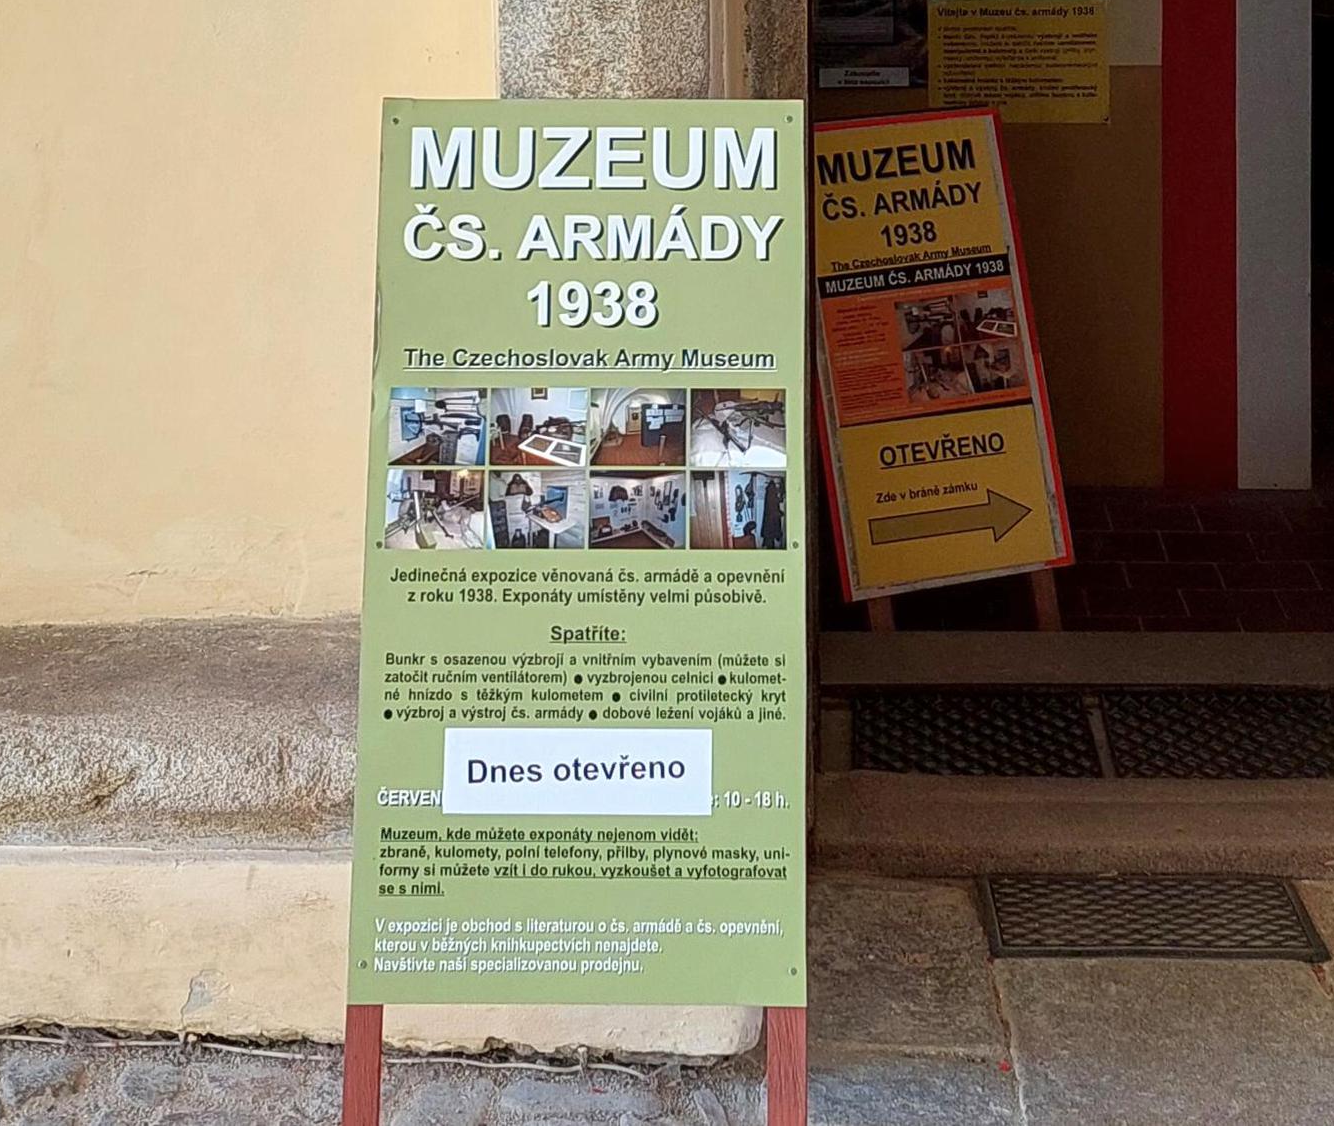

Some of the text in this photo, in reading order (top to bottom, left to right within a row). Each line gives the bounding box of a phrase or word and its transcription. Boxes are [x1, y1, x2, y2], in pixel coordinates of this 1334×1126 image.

[980, 8, 1012, 16] Muzeu
[1032, 7, 1068, 18] armády
[409, 126, 777, 190] MUZEUM
[817, 138, 976, 186] MUZEUM
[822, 179, 982, 222] ČS. ARMÁDY
[403, 204, 784, 262] ČS. ARMÁDY
[880, 220, 938, 248] 1938
[831, 244, 992, 272] The Czechoslovak Army Museum
[825, 276, 885, 294] MUZEUM
[888, 273, 912, 285] ČS.
[914, 263, 972, 283] ARMÁDY
[976, 259, 1004, 274] 1938
[526, 281, 659, 327] 1938
[404, 347, 775, 371] The Czechoslovak Army Museum
[880, 432, 1006, 467] OTEVŘENO
[876, 480, 978, 503] Zde v bráně zámku
[390, 568, 785, 586] Jedinečná expozice věnovaná čs. armádě a opevnění
[407, 589, 766, 606] z roku 1938. Exponáty umístěny velmi působivě.
[550, 626, 626, 643] Spatříte:
[386, 653, 785, 669] Bunkr s osazenou výzbrojí a vnitřním vybavením (můžete si
[385, 671, 786, 687] zatočit ručním ventilátorem) vyzbrojenou celnici kulomet-
[385, 689, 400, 701] né
[409, 689, 452, 701] hnízdo
[461, 693, 468, 701] s
[477, 689, 522, 704] těžkým
[531, 689, 603, 701] kulometem
[630, 689, 667, 701] civilní
[762, 690, 786, 705] kryt
[396, 707, 785, 723] výzbroj a výstroj čs. armády dobové ležení vojáků a jiné.
[467, 755, 686, 783] Dnes otevřeno
[724, 791, 741, 807] 10
[755, 792, 772, 808] 18
[776, 791, 790, 808] h.
[380, 828, 442, 841] Muzeum,
[446, 828, 471, 839] kde
[476, 828, 524, 839] můžete
[530, 828, 592, 843] exponáty
[597, 828, 655, 843] nejenom
[435, 846, 501, 861] kulomety,
[505, 846, 539, 861] polní
[544, 846, 602, 862] telefony,
[607, 847, 648, 862] přilby,
[654, 847, 707, 862] plynové
[712, 847, 759, 862] masky,
[764, 847, 790, 858] uni-
[379, 864, 787, 880] formy si můžete vzít i do rukou, vyzkoušet a vyfotografovat
[379, 882, 444, 894] se s nimi.
[375, 918, 386, 932] V
[388, 918, 442, 936] expozici
[445, 918, 458, 936] je
[462, 919, 511, 932] obchod
[515, 922, 522, 932] s
[527, 919, 594, 932] literaturou
[598, 922, 606, 932] o
[610, 919, 629, 932] čs.
[685, 923, 692, 933] a
[697, 919, 716, 933] čs.
[720, 919, 783, 936] opevnění,
[375, 938, 662, 955] kterou v běžných knihkupectvích nenajdete.
[374, 958, 435, 970] Navštivte
[471, 958, 577, 974] specializovanou
[581, 958, 643, 975] prodejnu.
